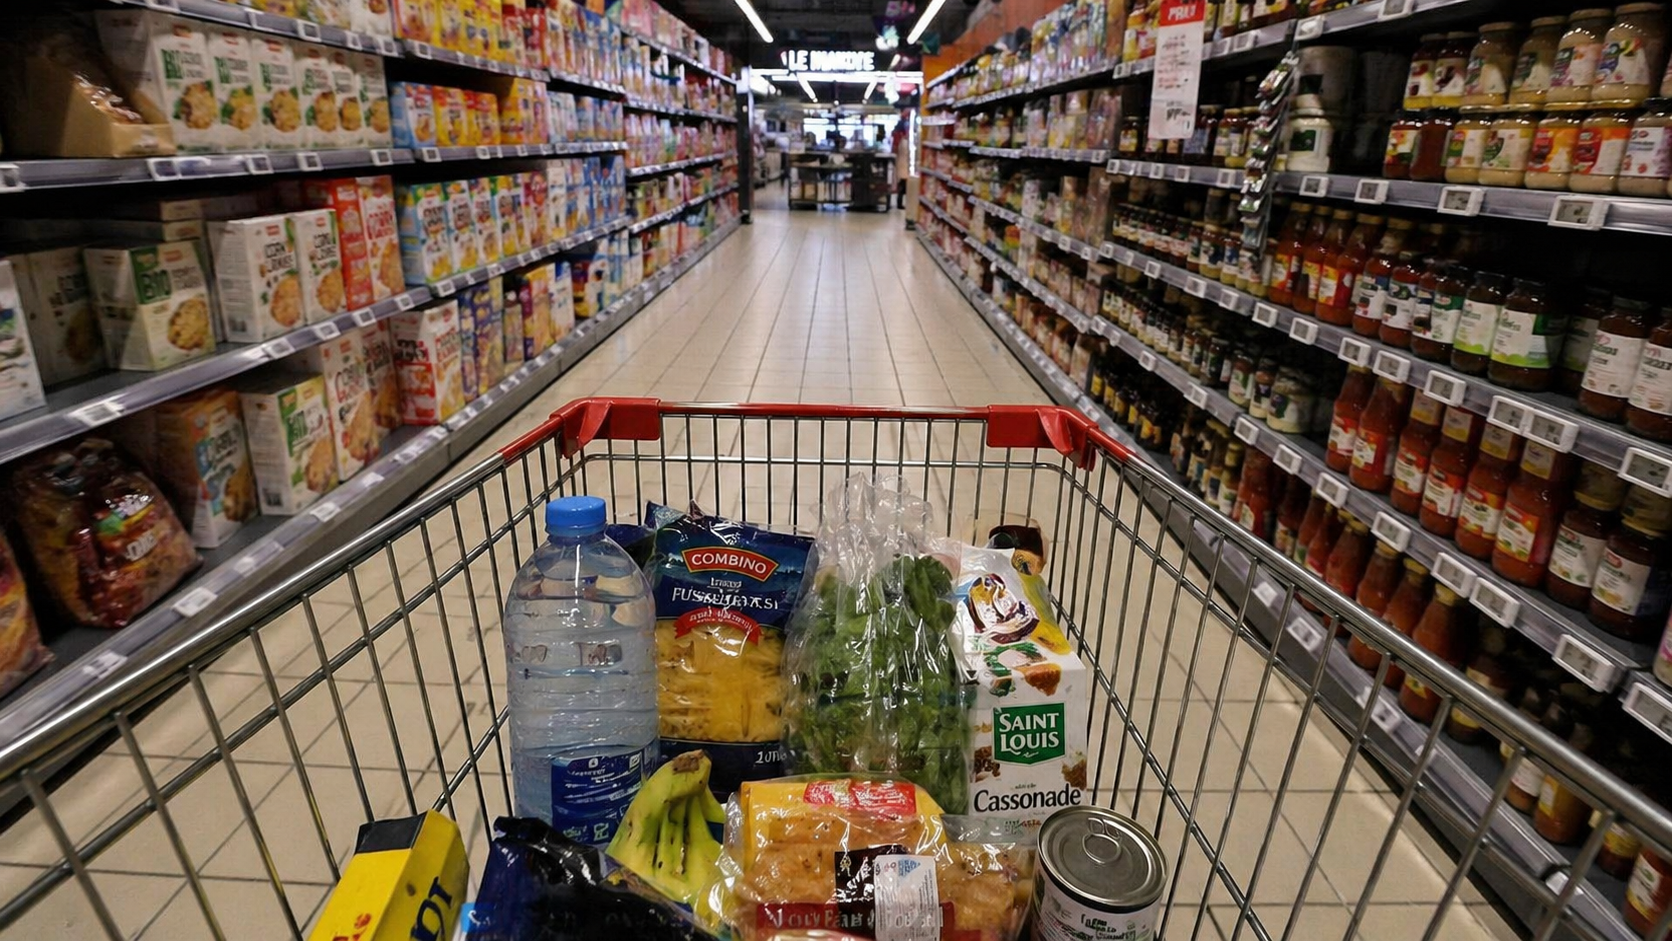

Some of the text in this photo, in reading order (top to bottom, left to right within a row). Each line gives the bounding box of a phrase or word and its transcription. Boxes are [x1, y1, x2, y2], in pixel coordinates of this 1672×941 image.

[788, 50, 809, 71] LE
[691, 553, 767, 574] COMBINO
[999, 713, 1059, 732] SAINT
[1000, 732, 1060, 755] LOUIS
[973, 783, 1081, 813] Cassonade
